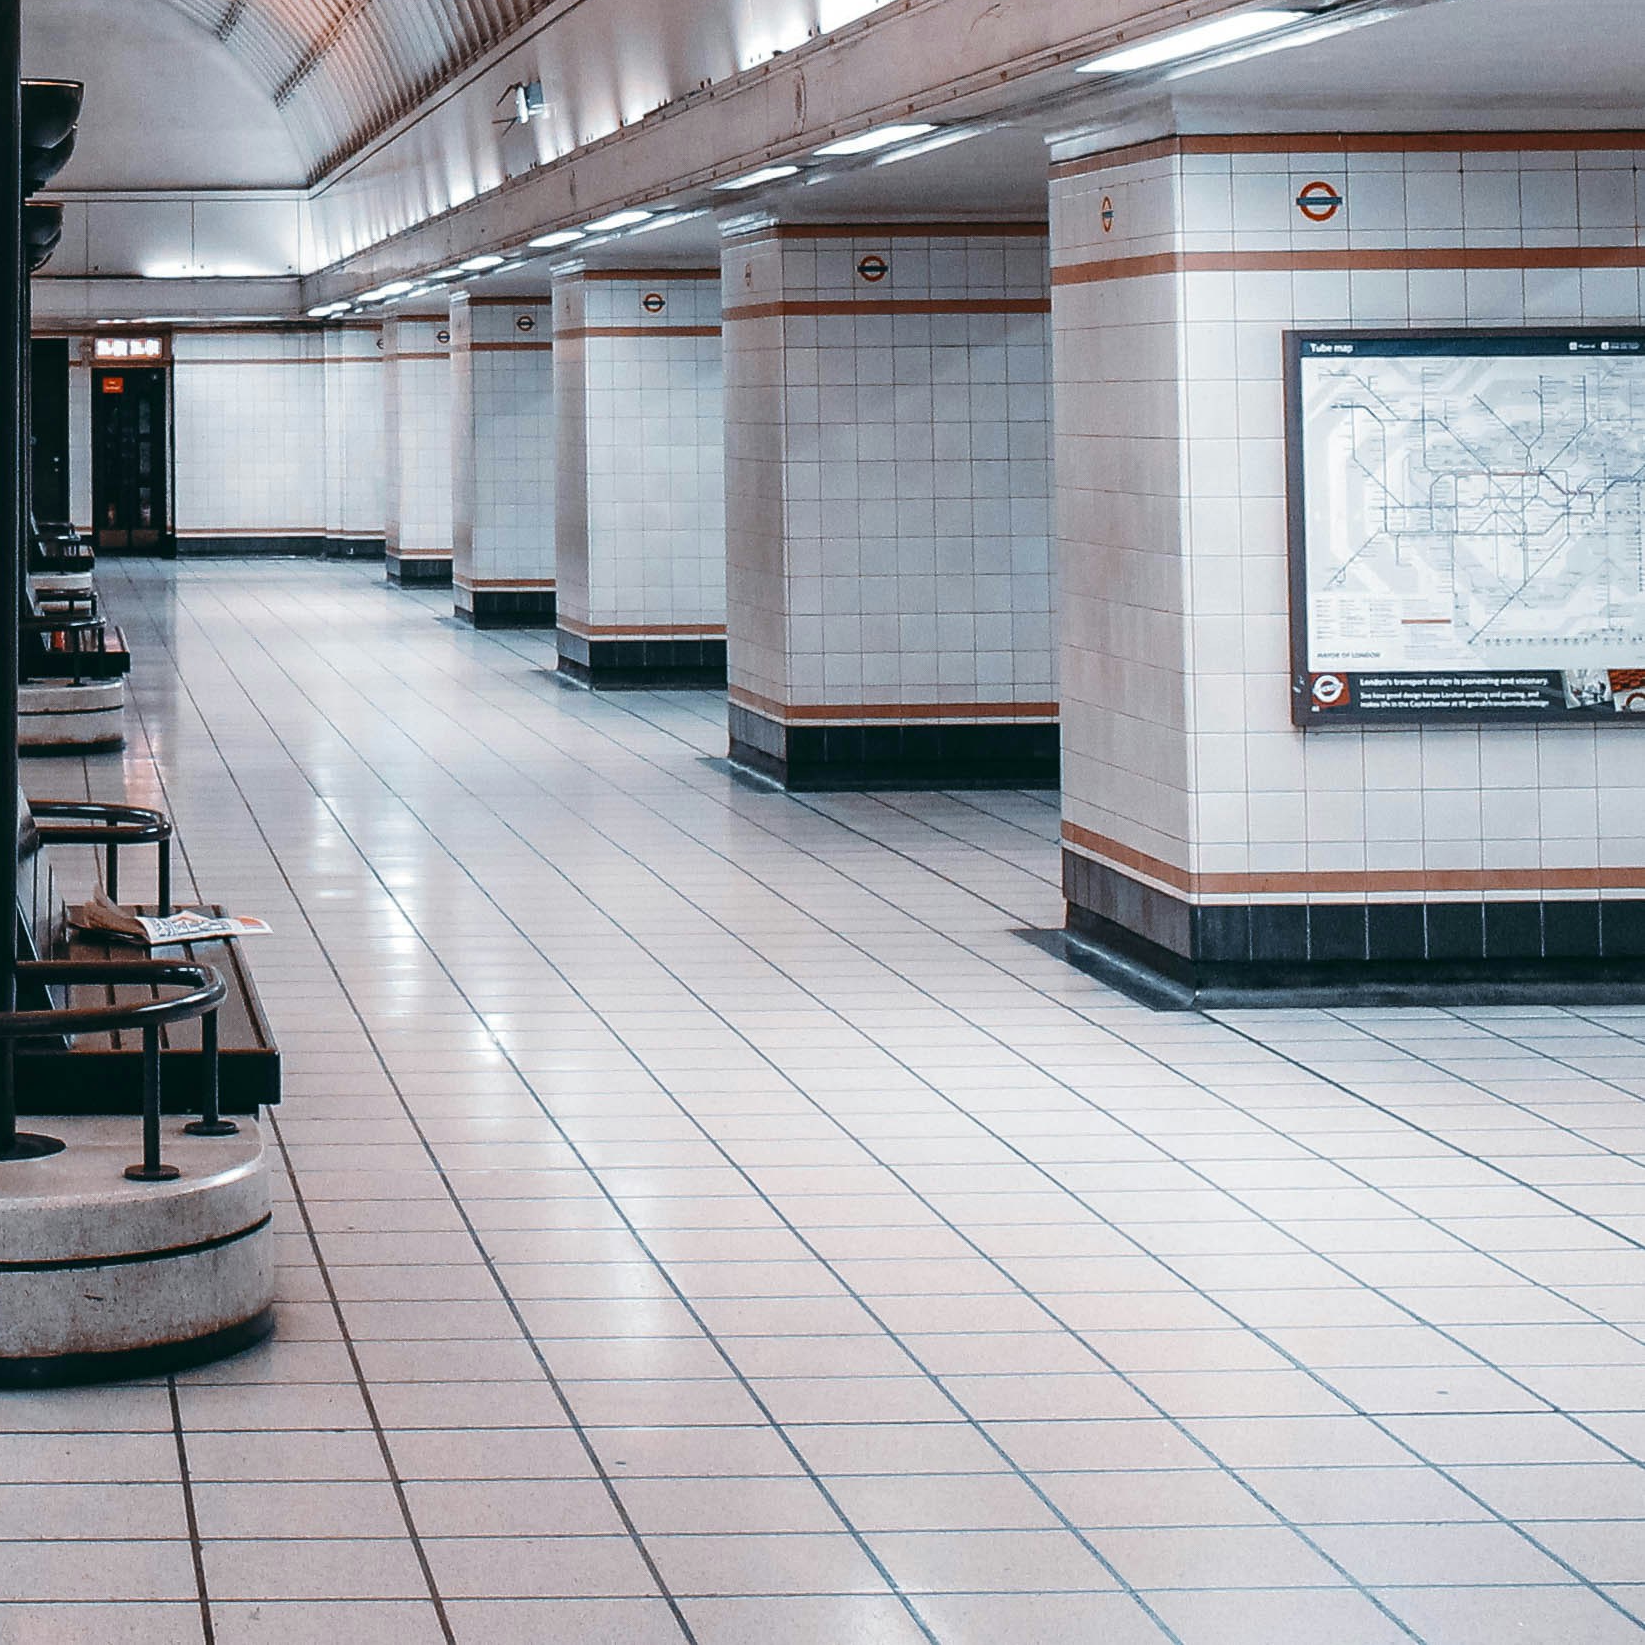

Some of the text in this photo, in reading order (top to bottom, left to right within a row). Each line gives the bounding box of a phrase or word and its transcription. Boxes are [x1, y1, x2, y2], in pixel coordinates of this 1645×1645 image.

[1310, 343, 1354, 354] Tube map
[1359, 678, 1393, 686] London's
[1394, 678, 1428, 688] transport
[1428, 678, 1453, 687] design
[1461, 677, 1500, 687] pioneering
[1500, 677, 1514, 685] and
[1515, 677, 1549, 686] visionary.
[1386, 692, 1402, 700] good
[1441, 691, 1464, 699] London
[1465, 691, 1488, 700] working
[1409, 700, 1430, 708] Capital
